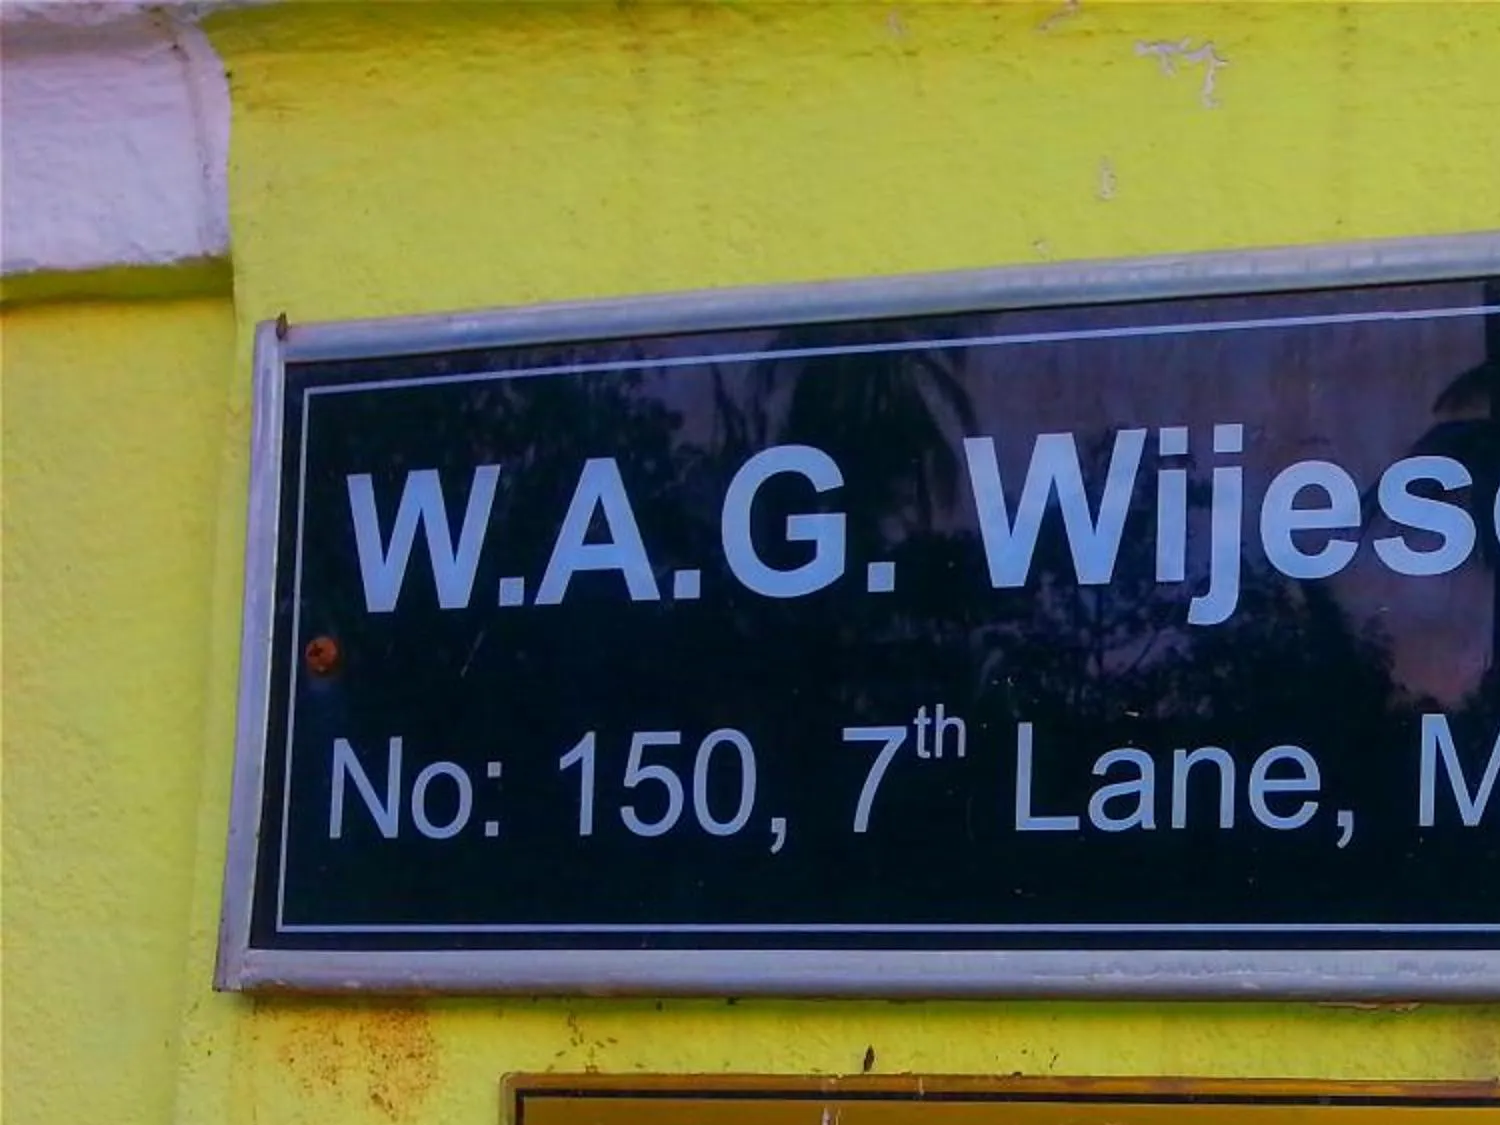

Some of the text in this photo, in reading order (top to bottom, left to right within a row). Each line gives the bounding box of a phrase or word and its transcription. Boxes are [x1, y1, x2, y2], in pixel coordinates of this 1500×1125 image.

[346, 445, 896, 613] W.A.G.
[329, 736, 500, 839] No:
[559, 729, 788, 853] 150,
[842, 704, 967, 834] 7th
[1014, 722, 1355, 849] Lane,
